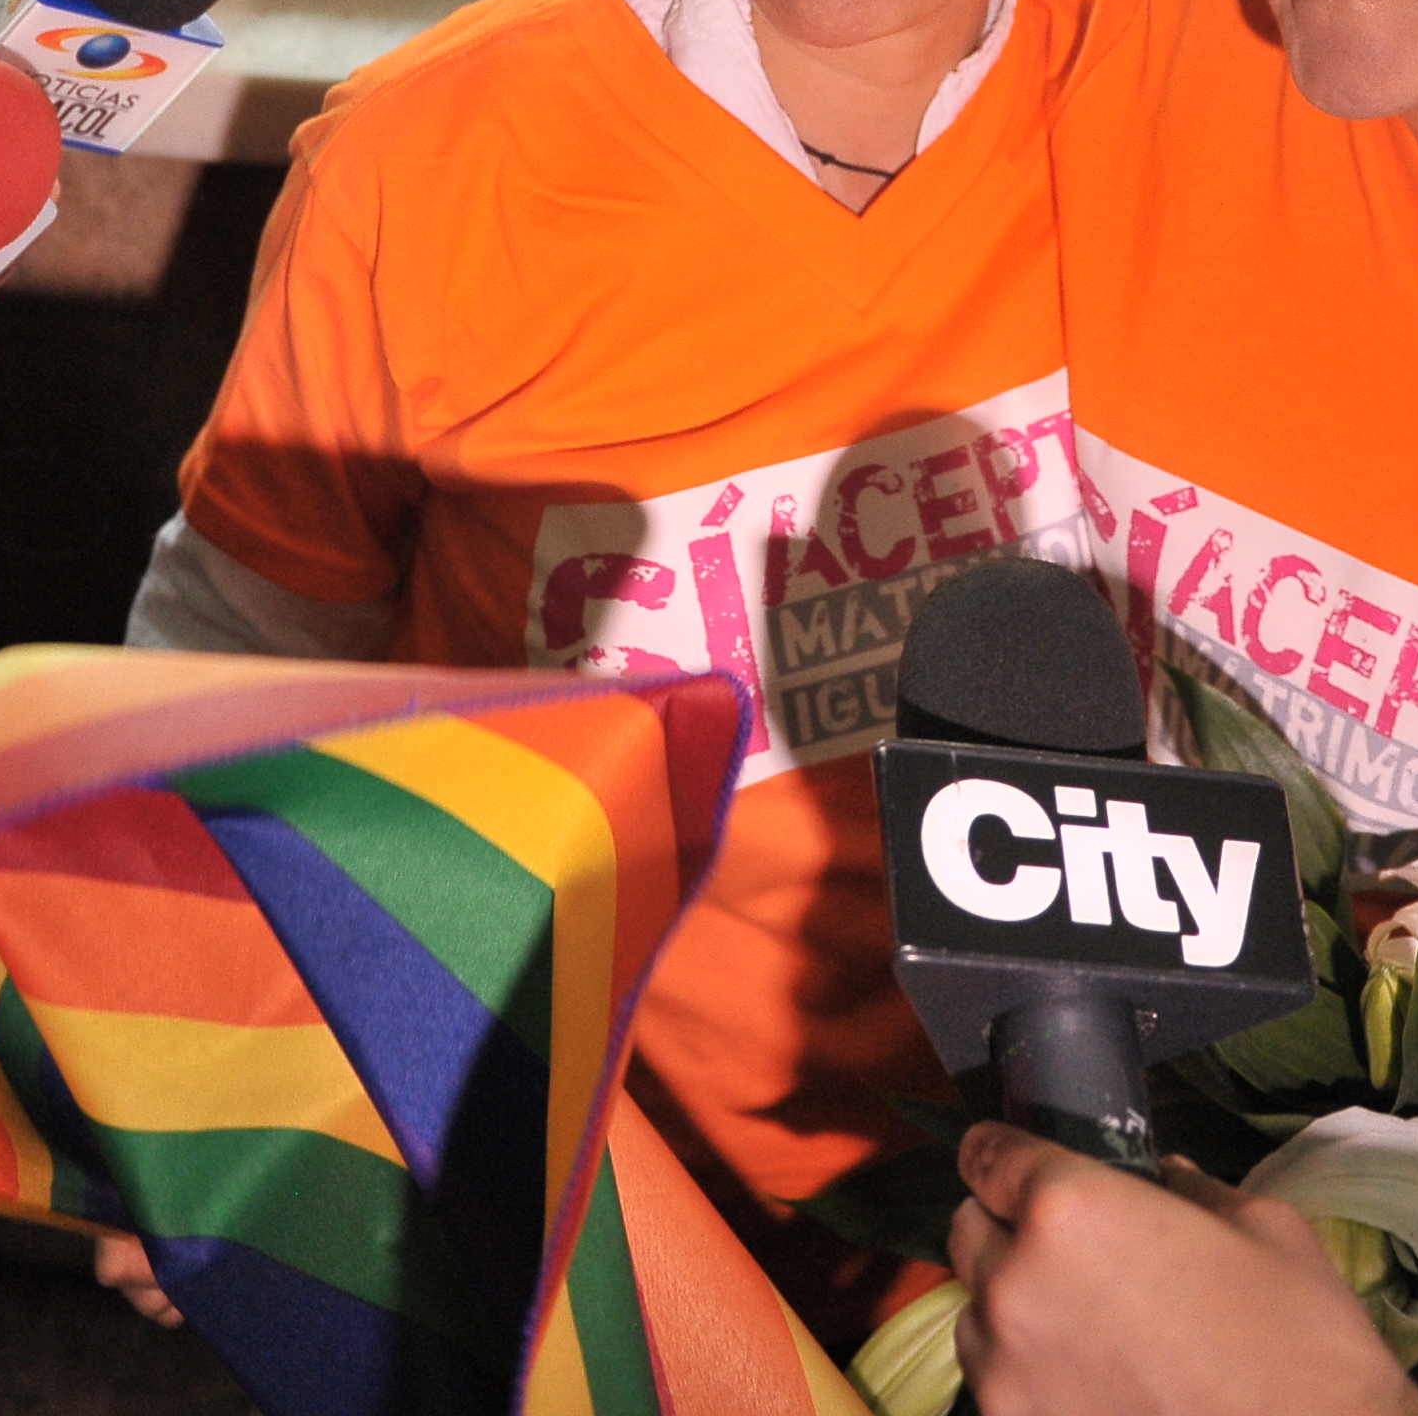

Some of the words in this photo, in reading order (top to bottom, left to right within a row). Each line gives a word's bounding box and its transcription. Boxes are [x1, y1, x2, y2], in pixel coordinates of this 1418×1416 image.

[25, 69, 140, 109] OTICIAS
[763, 408, 1083, 608] ACEPT
[921, 778, 1261, 967] City
